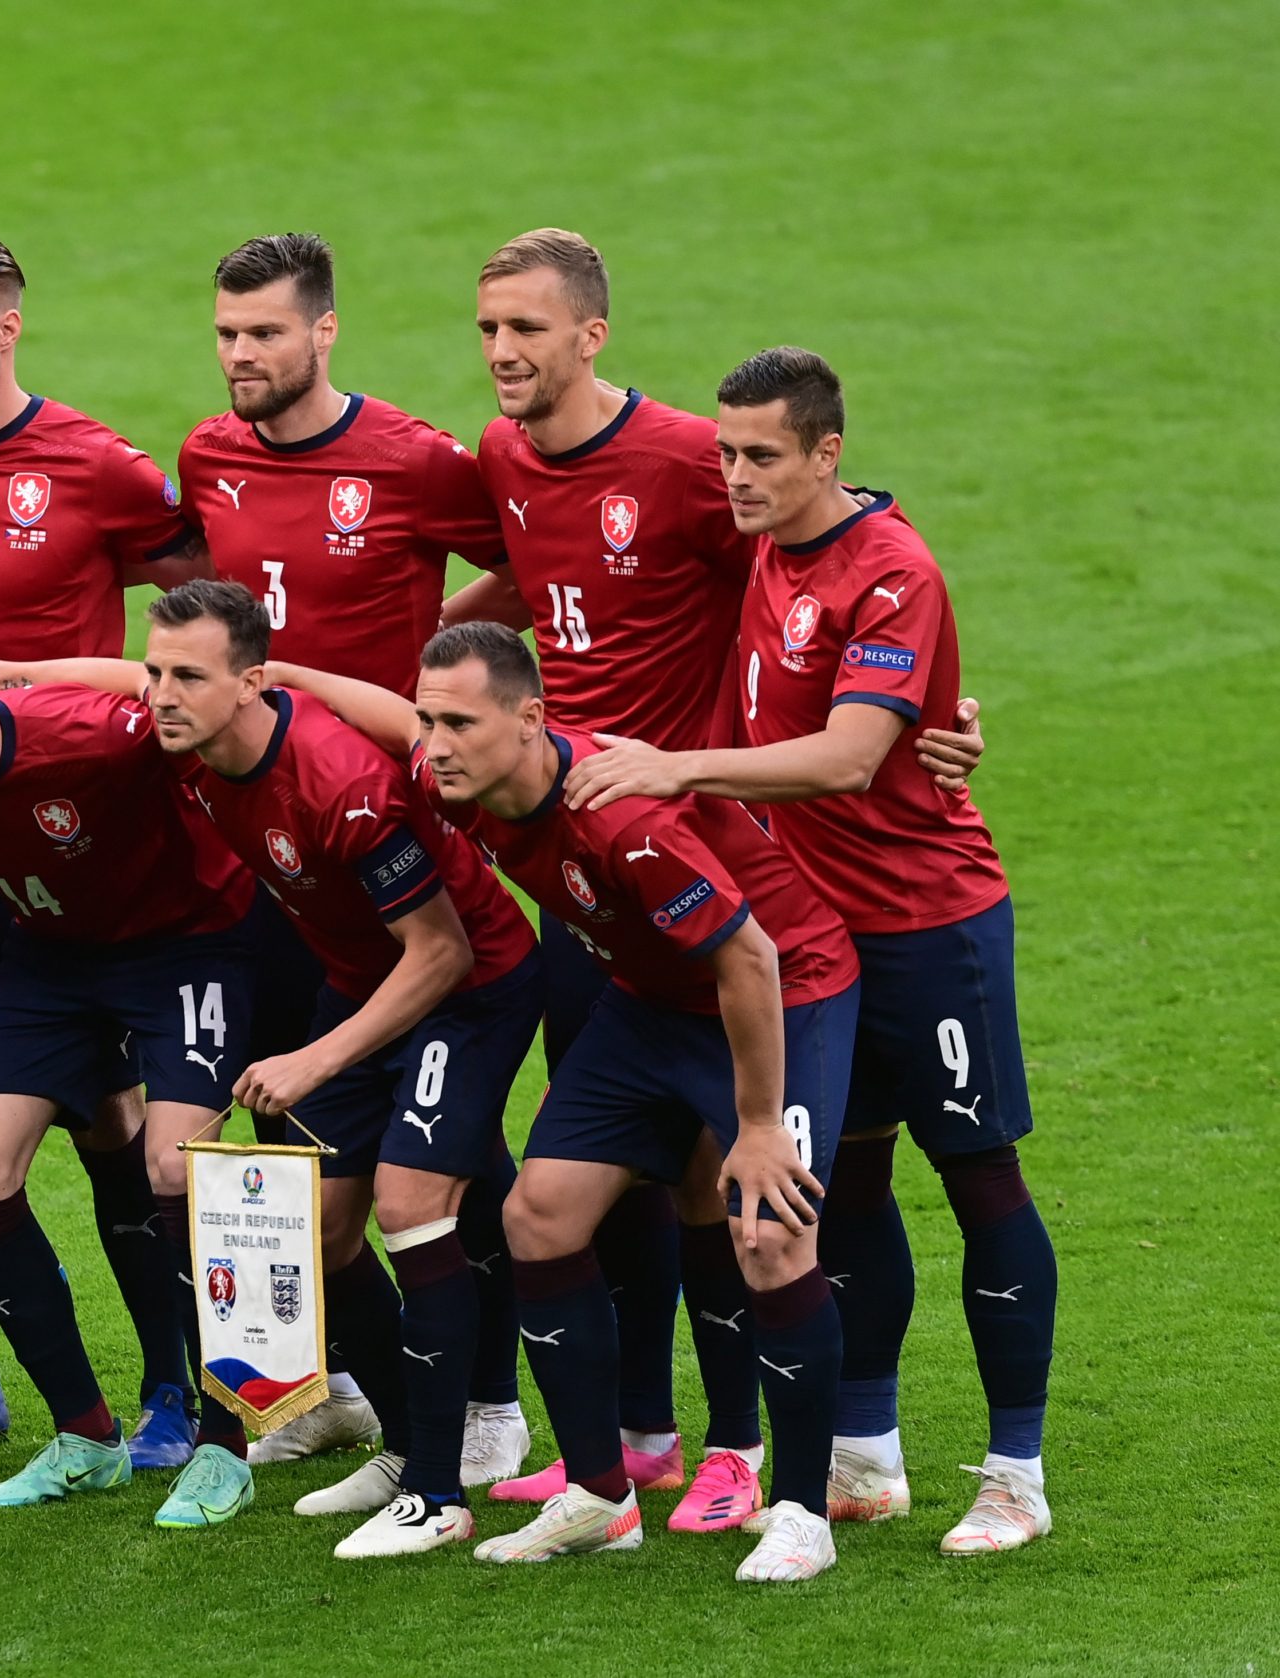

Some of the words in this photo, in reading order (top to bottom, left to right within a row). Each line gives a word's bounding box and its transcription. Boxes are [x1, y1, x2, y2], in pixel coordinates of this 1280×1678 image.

[261, 560, 287, 631] 3
[547, 583, 592, 653] 15
[747, 650, 761, 721] 9
[864, 650, 913, 667] RESPECT
[668, 881, 711, 917] RESPECT
[178, 982, 227, 1048] 14
[414, 1040, 449, 1107] 8
[936, 1018, 970, 1089] 9
[200, 1211, 240, 1227] CZECH
[245, 1213, 305, 1230] REPUBLIC
[223, 1234, 281, 1250] ENGLAND
[245, 1326, 266, 1334] London
